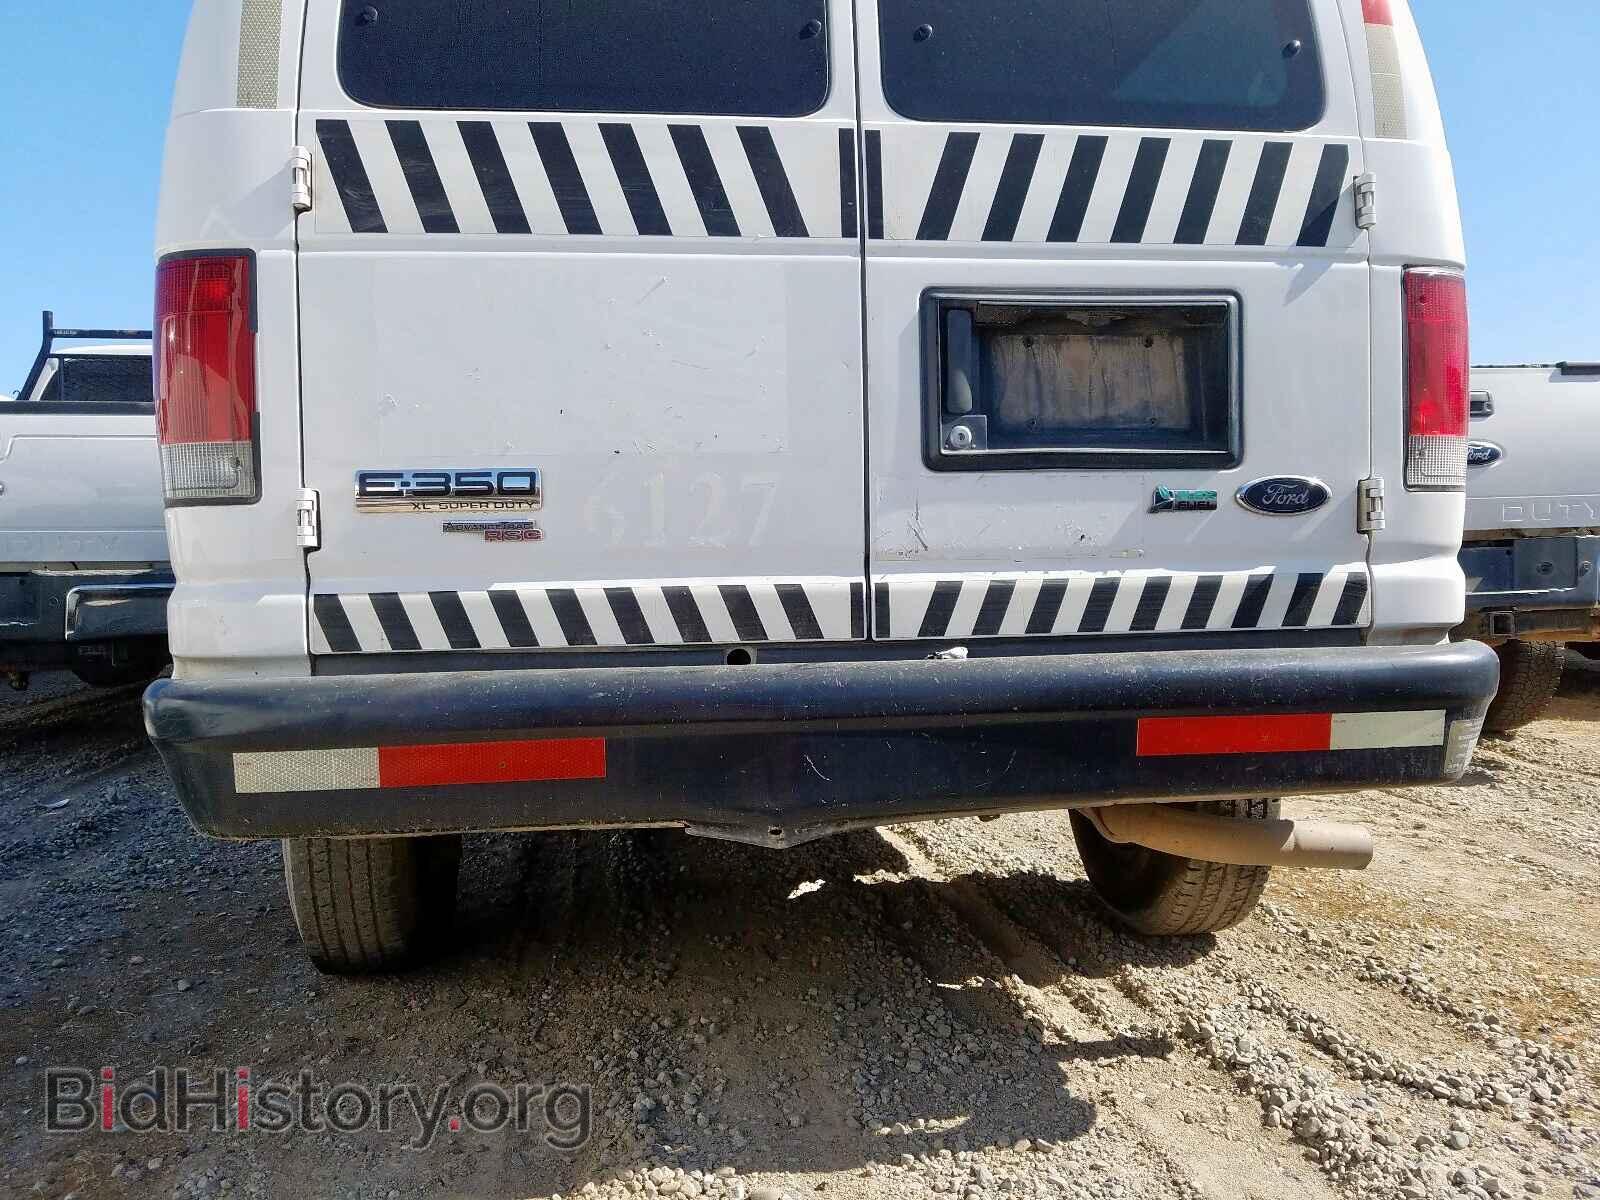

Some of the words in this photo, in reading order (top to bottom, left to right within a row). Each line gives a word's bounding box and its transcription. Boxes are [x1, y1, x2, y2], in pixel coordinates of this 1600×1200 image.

[1262, 483, 1311, 505] Ford
[412, 502, 432, 510] XL
[439, 502, 490, 510] SUPER
[494, 501, 535, 510] DUTY
[584, 471, 777, 551] 6127
[484, 529, 543, 542] RSC
